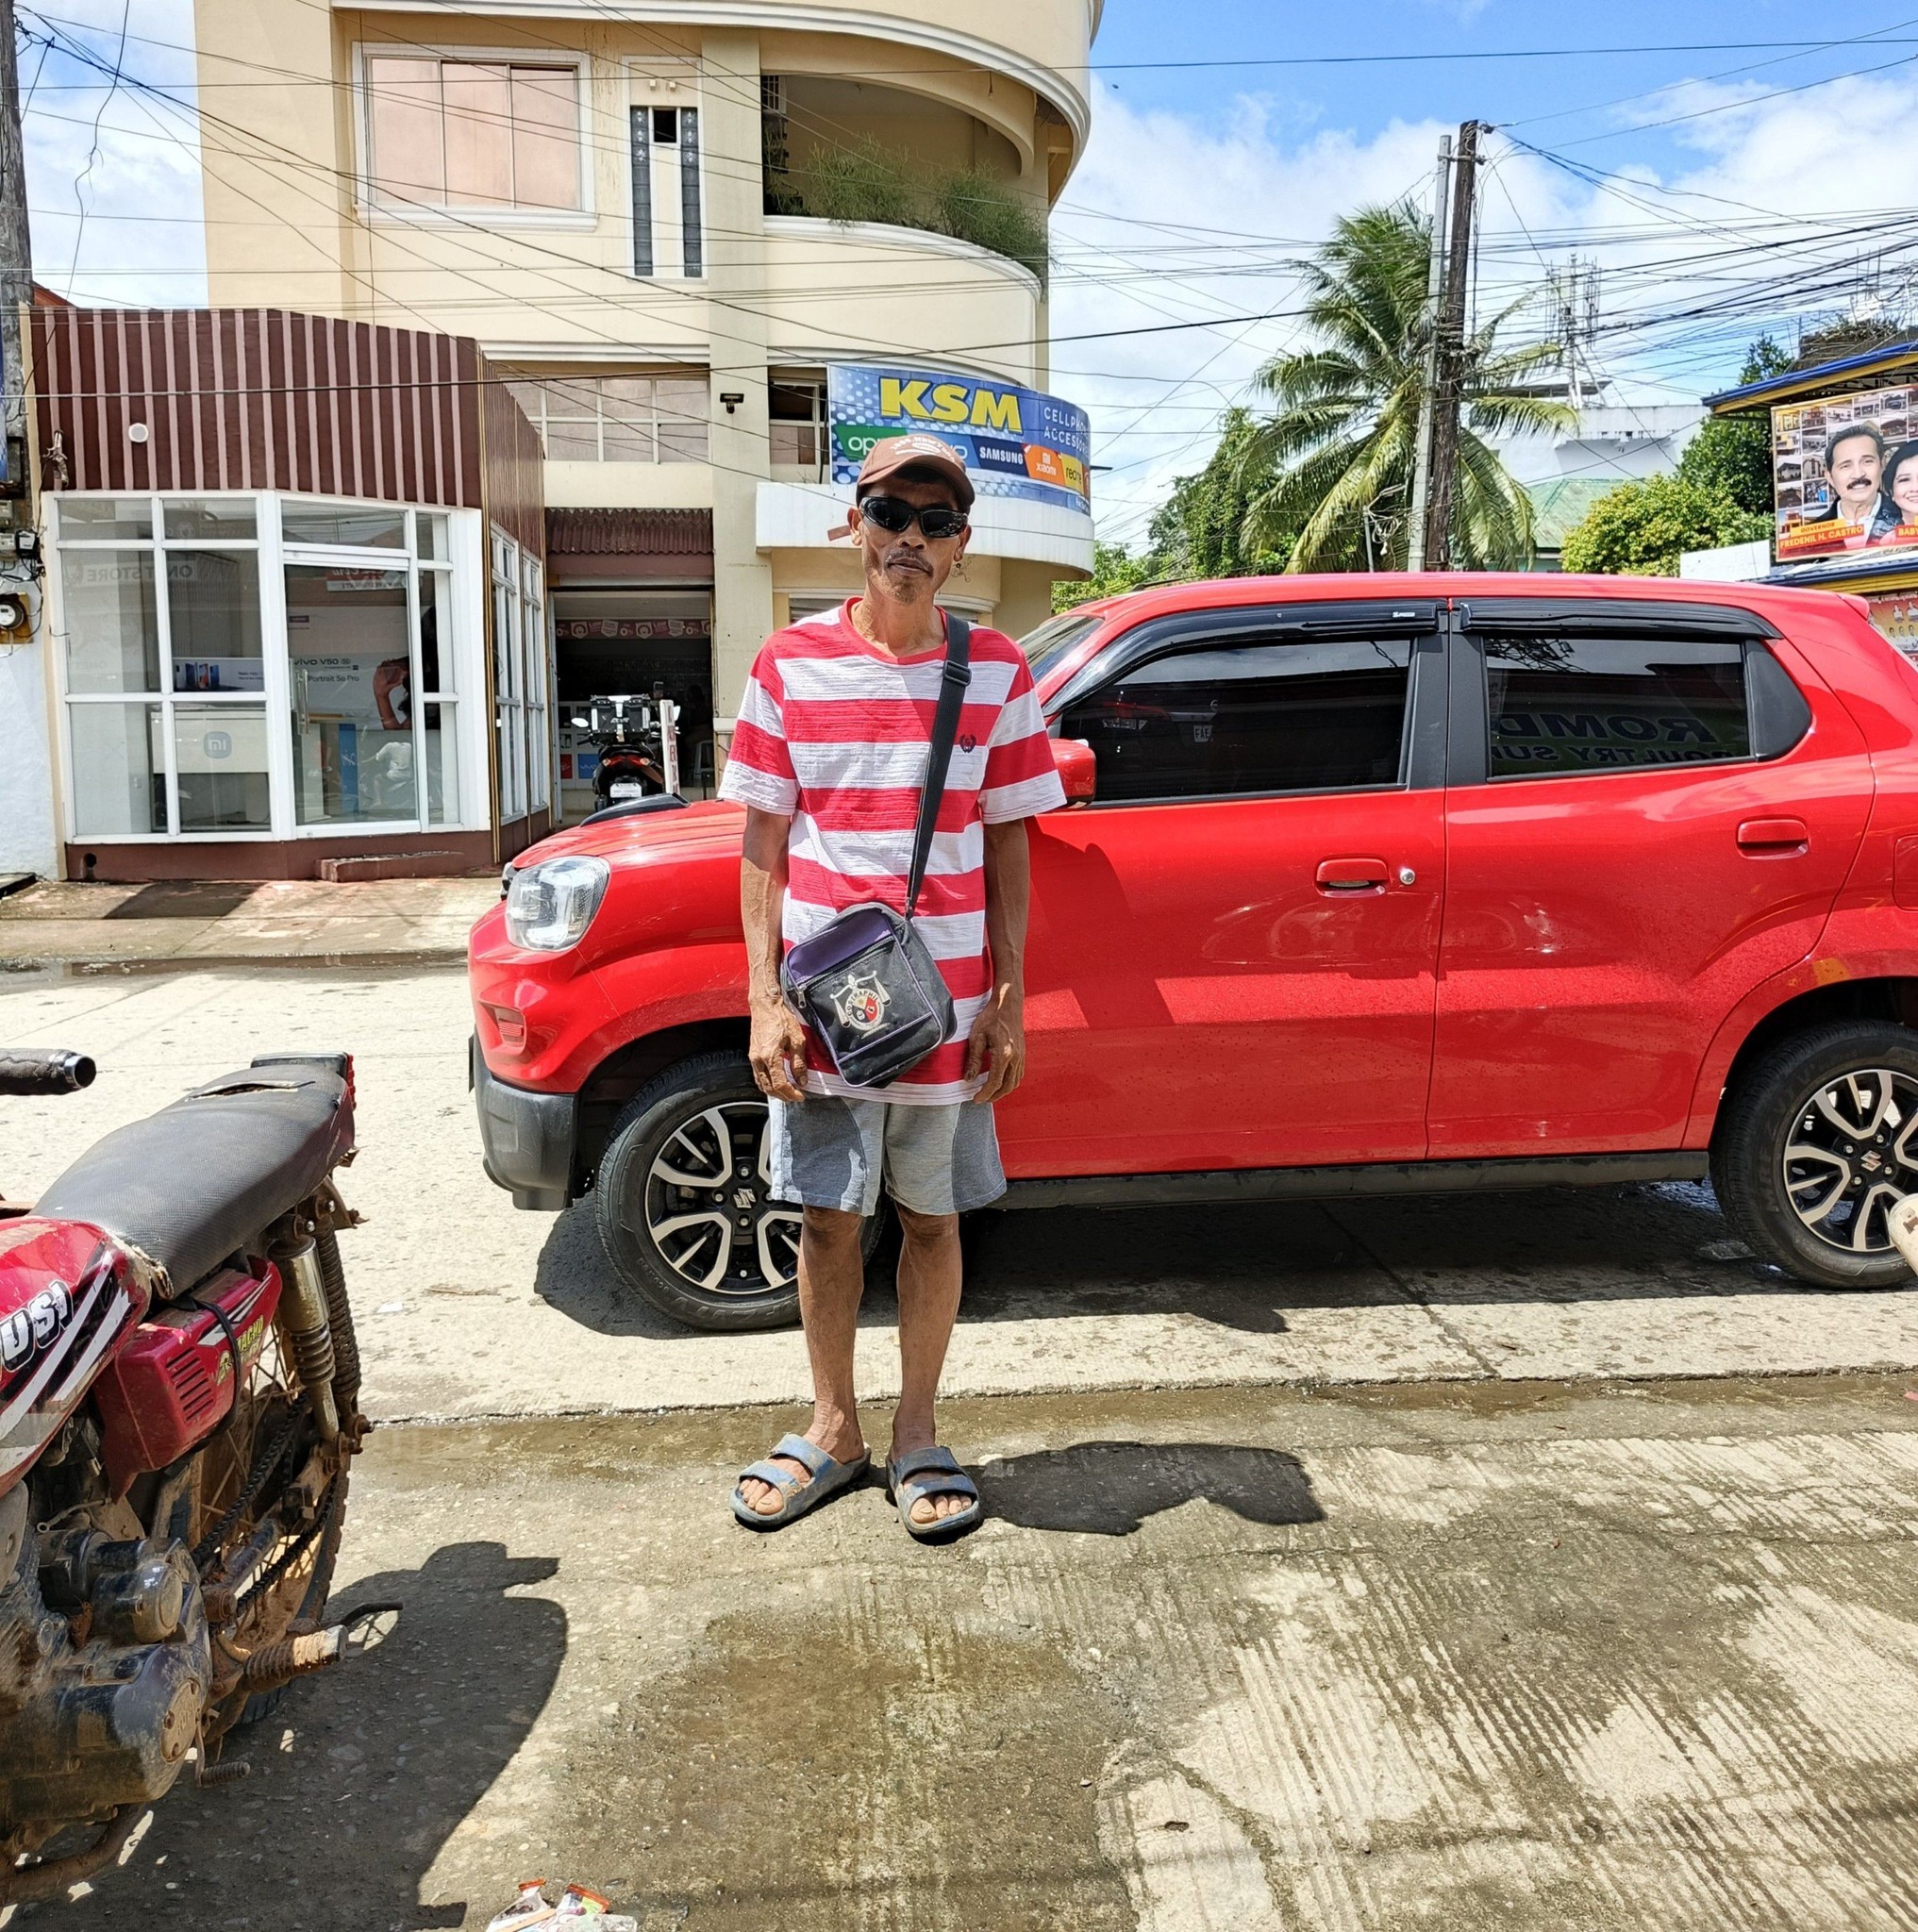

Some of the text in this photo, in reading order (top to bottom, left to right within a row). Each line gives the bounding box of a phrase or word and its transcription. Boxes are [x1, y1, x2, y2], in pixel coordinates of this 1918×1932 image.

[879, 376, 1024, 434] KSM
[979, 446, 1024, 465] SAMSUNG
[1779, 525, 1863, 548] FREDENIL H. CASTRO
[1801, 522, 1835, 533] GOVERNOR
